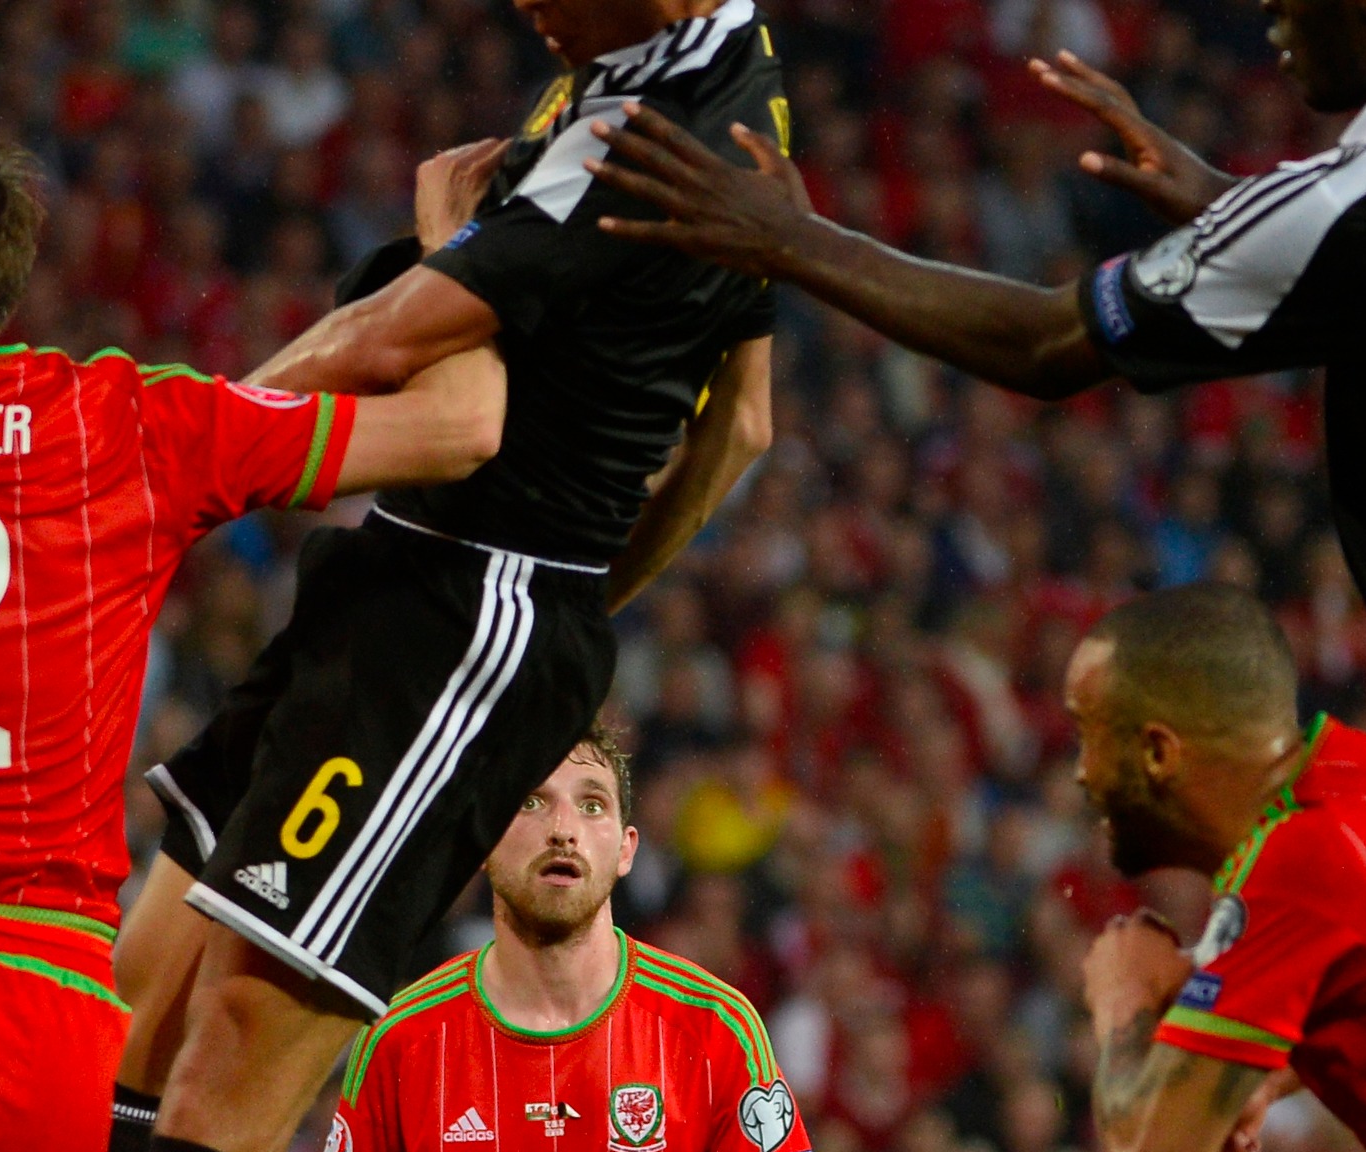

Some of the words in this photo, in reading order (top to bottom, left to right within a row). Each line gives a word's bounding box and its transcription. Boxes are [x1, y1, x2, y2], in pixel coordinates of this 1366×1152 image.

[280, 756, 362, 860] 6
[234, 868, 290, 910] adidas
[443, 1129, 495, 1142] adidas
